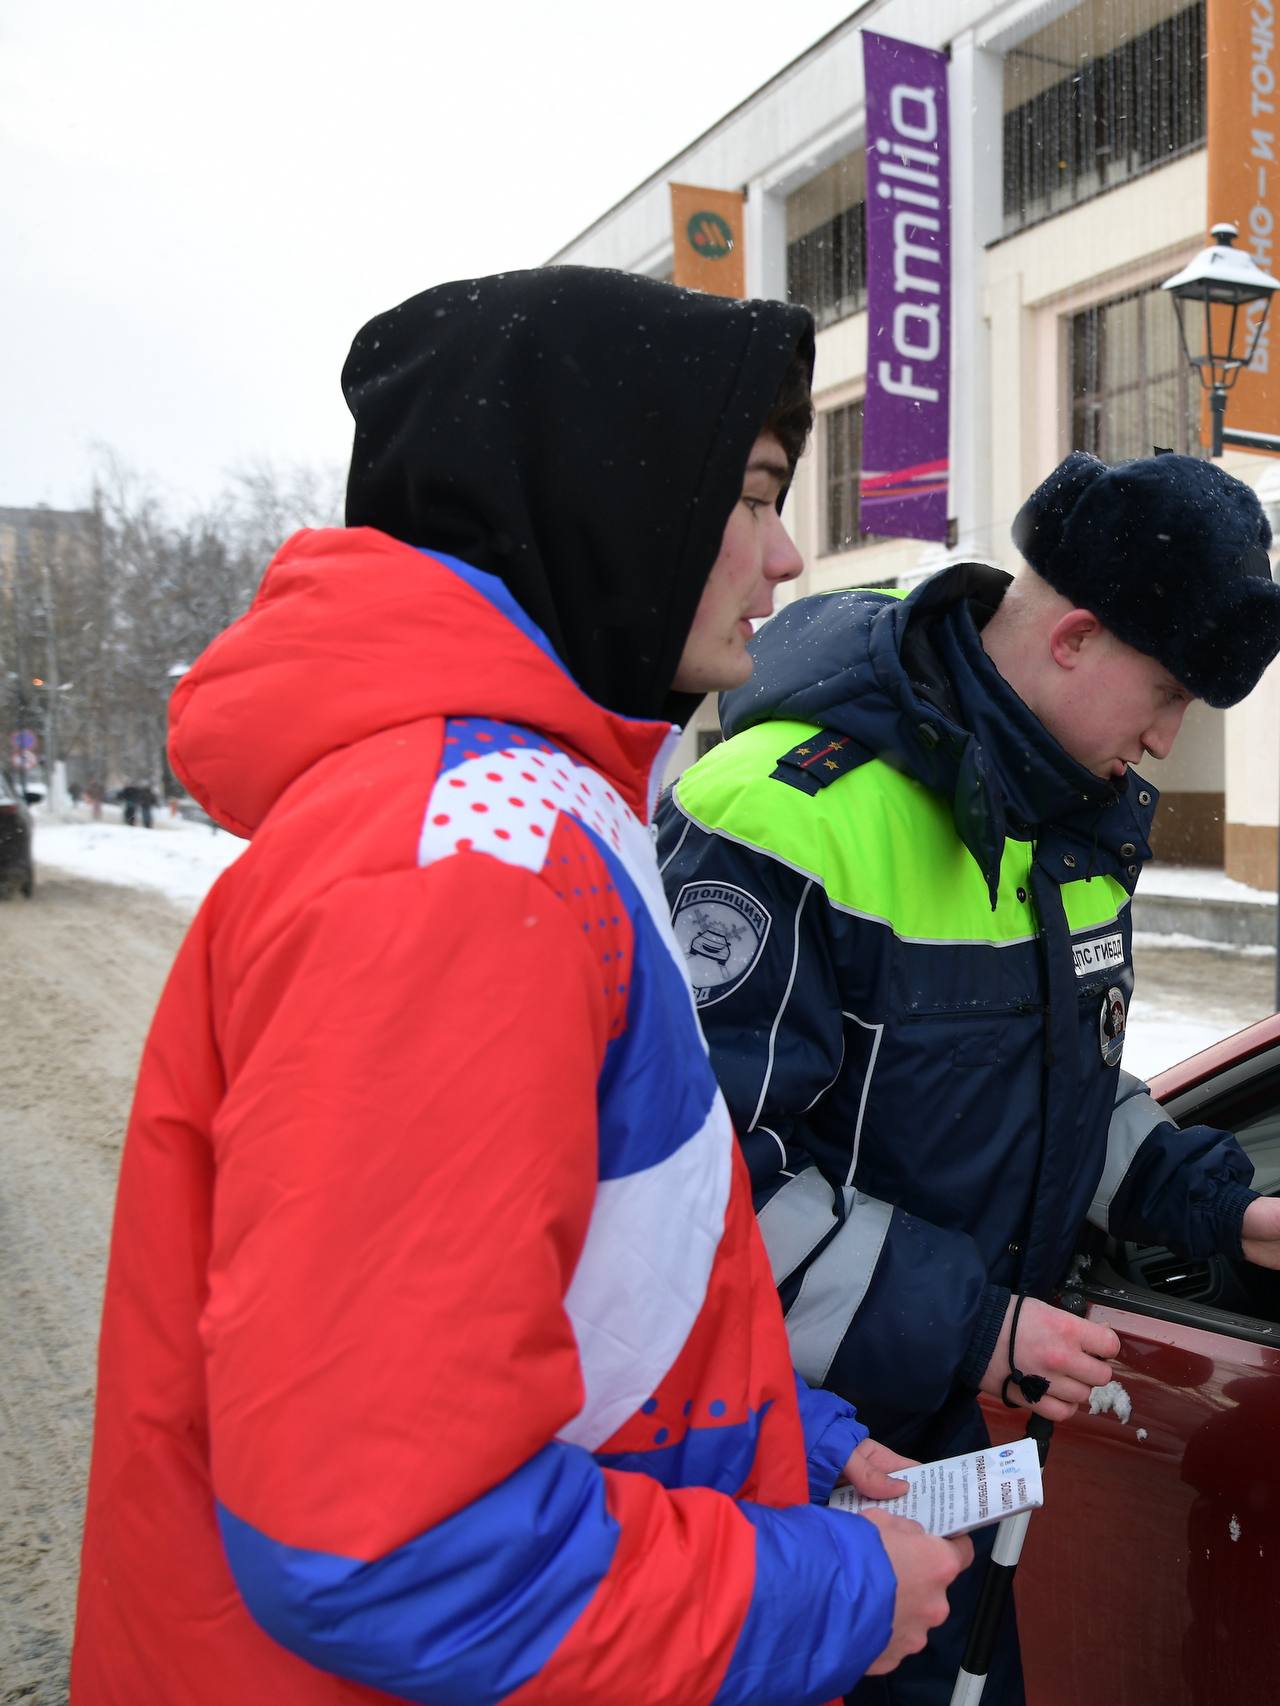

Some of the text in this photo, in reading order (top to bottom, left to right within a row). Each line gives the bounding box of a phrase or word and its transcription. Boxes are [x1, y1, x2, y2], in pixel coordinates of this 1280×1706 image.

[1251, 128, 1275, 161] И
[1245, 205, 1274, 374] ВКНО
[685, 889, 762, 928] ПОЛИЦИЯ
[1094, 939, 1123, 962] ГИБДД
